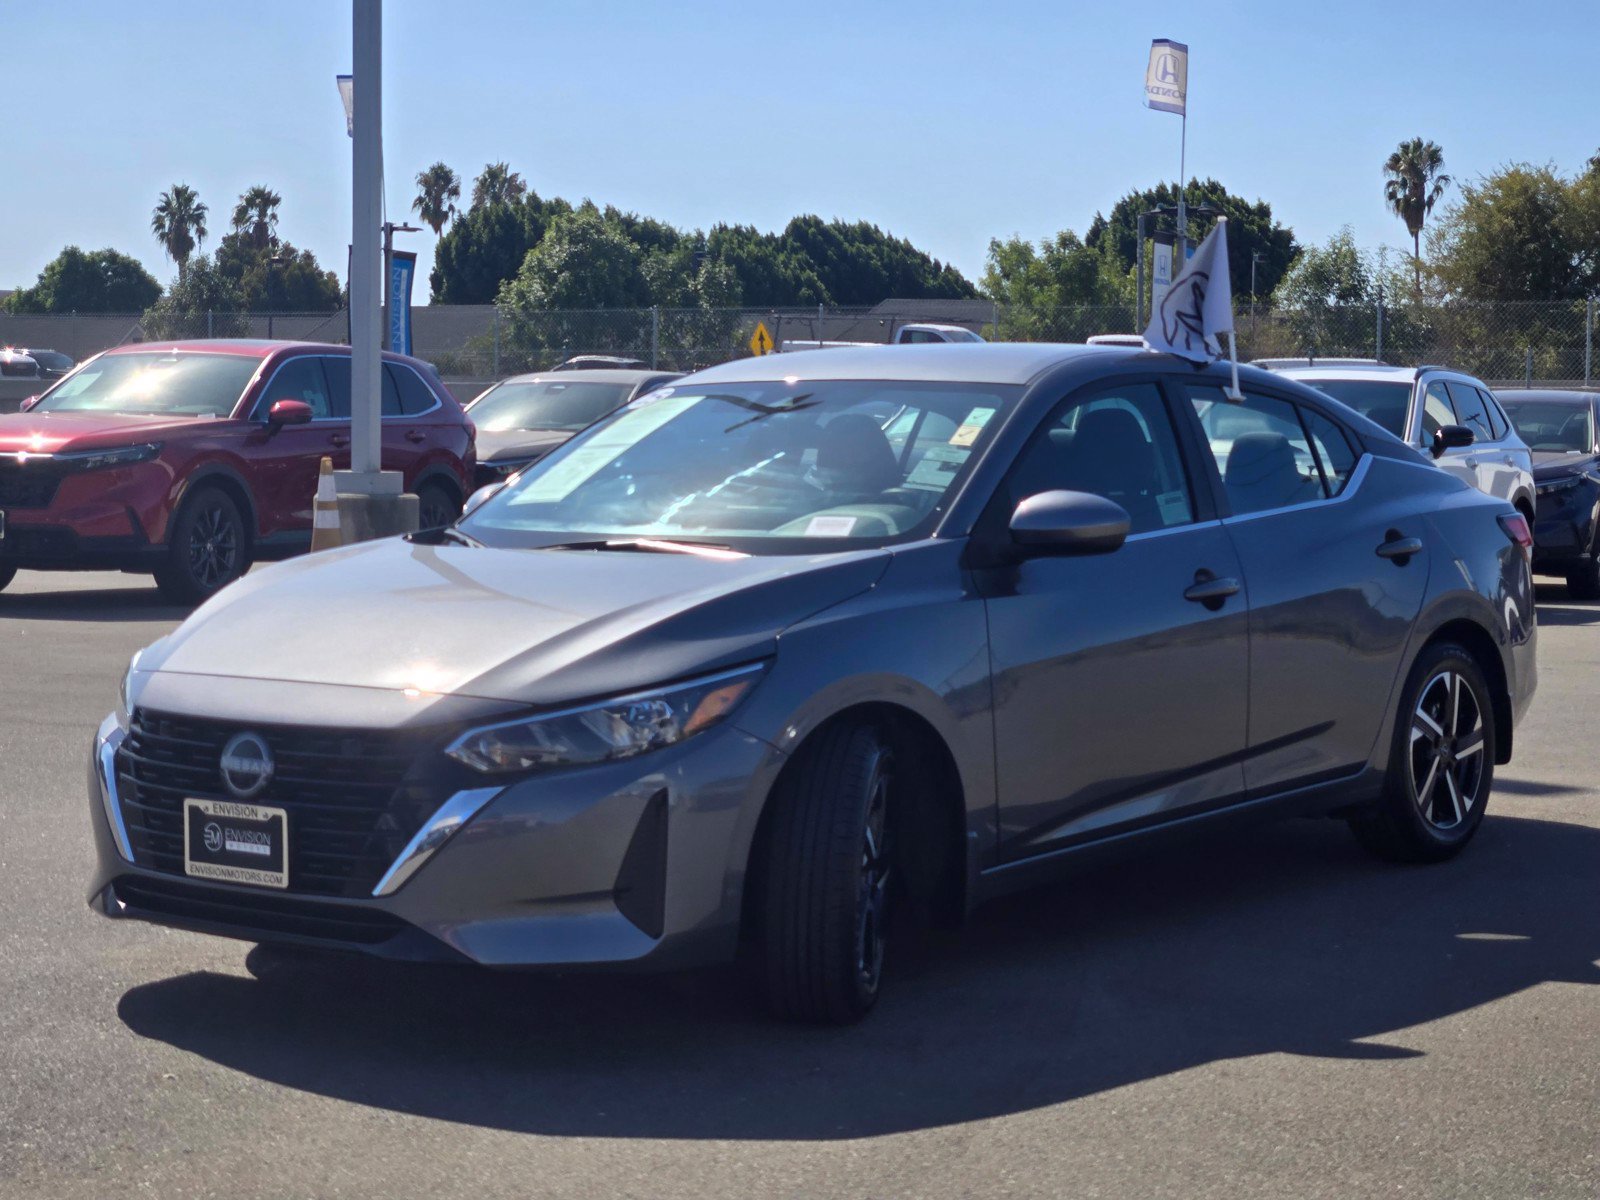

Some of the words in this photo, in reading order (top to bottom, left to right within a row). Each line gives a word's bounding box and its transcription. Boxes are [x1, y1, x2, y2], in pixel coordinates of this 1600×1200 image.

[212, 803, 258, 818] ENVISION
[225, 828, 271, 844] ENVISION
[190, 864, 283, 884] ENVISIONMOTORS.COM
